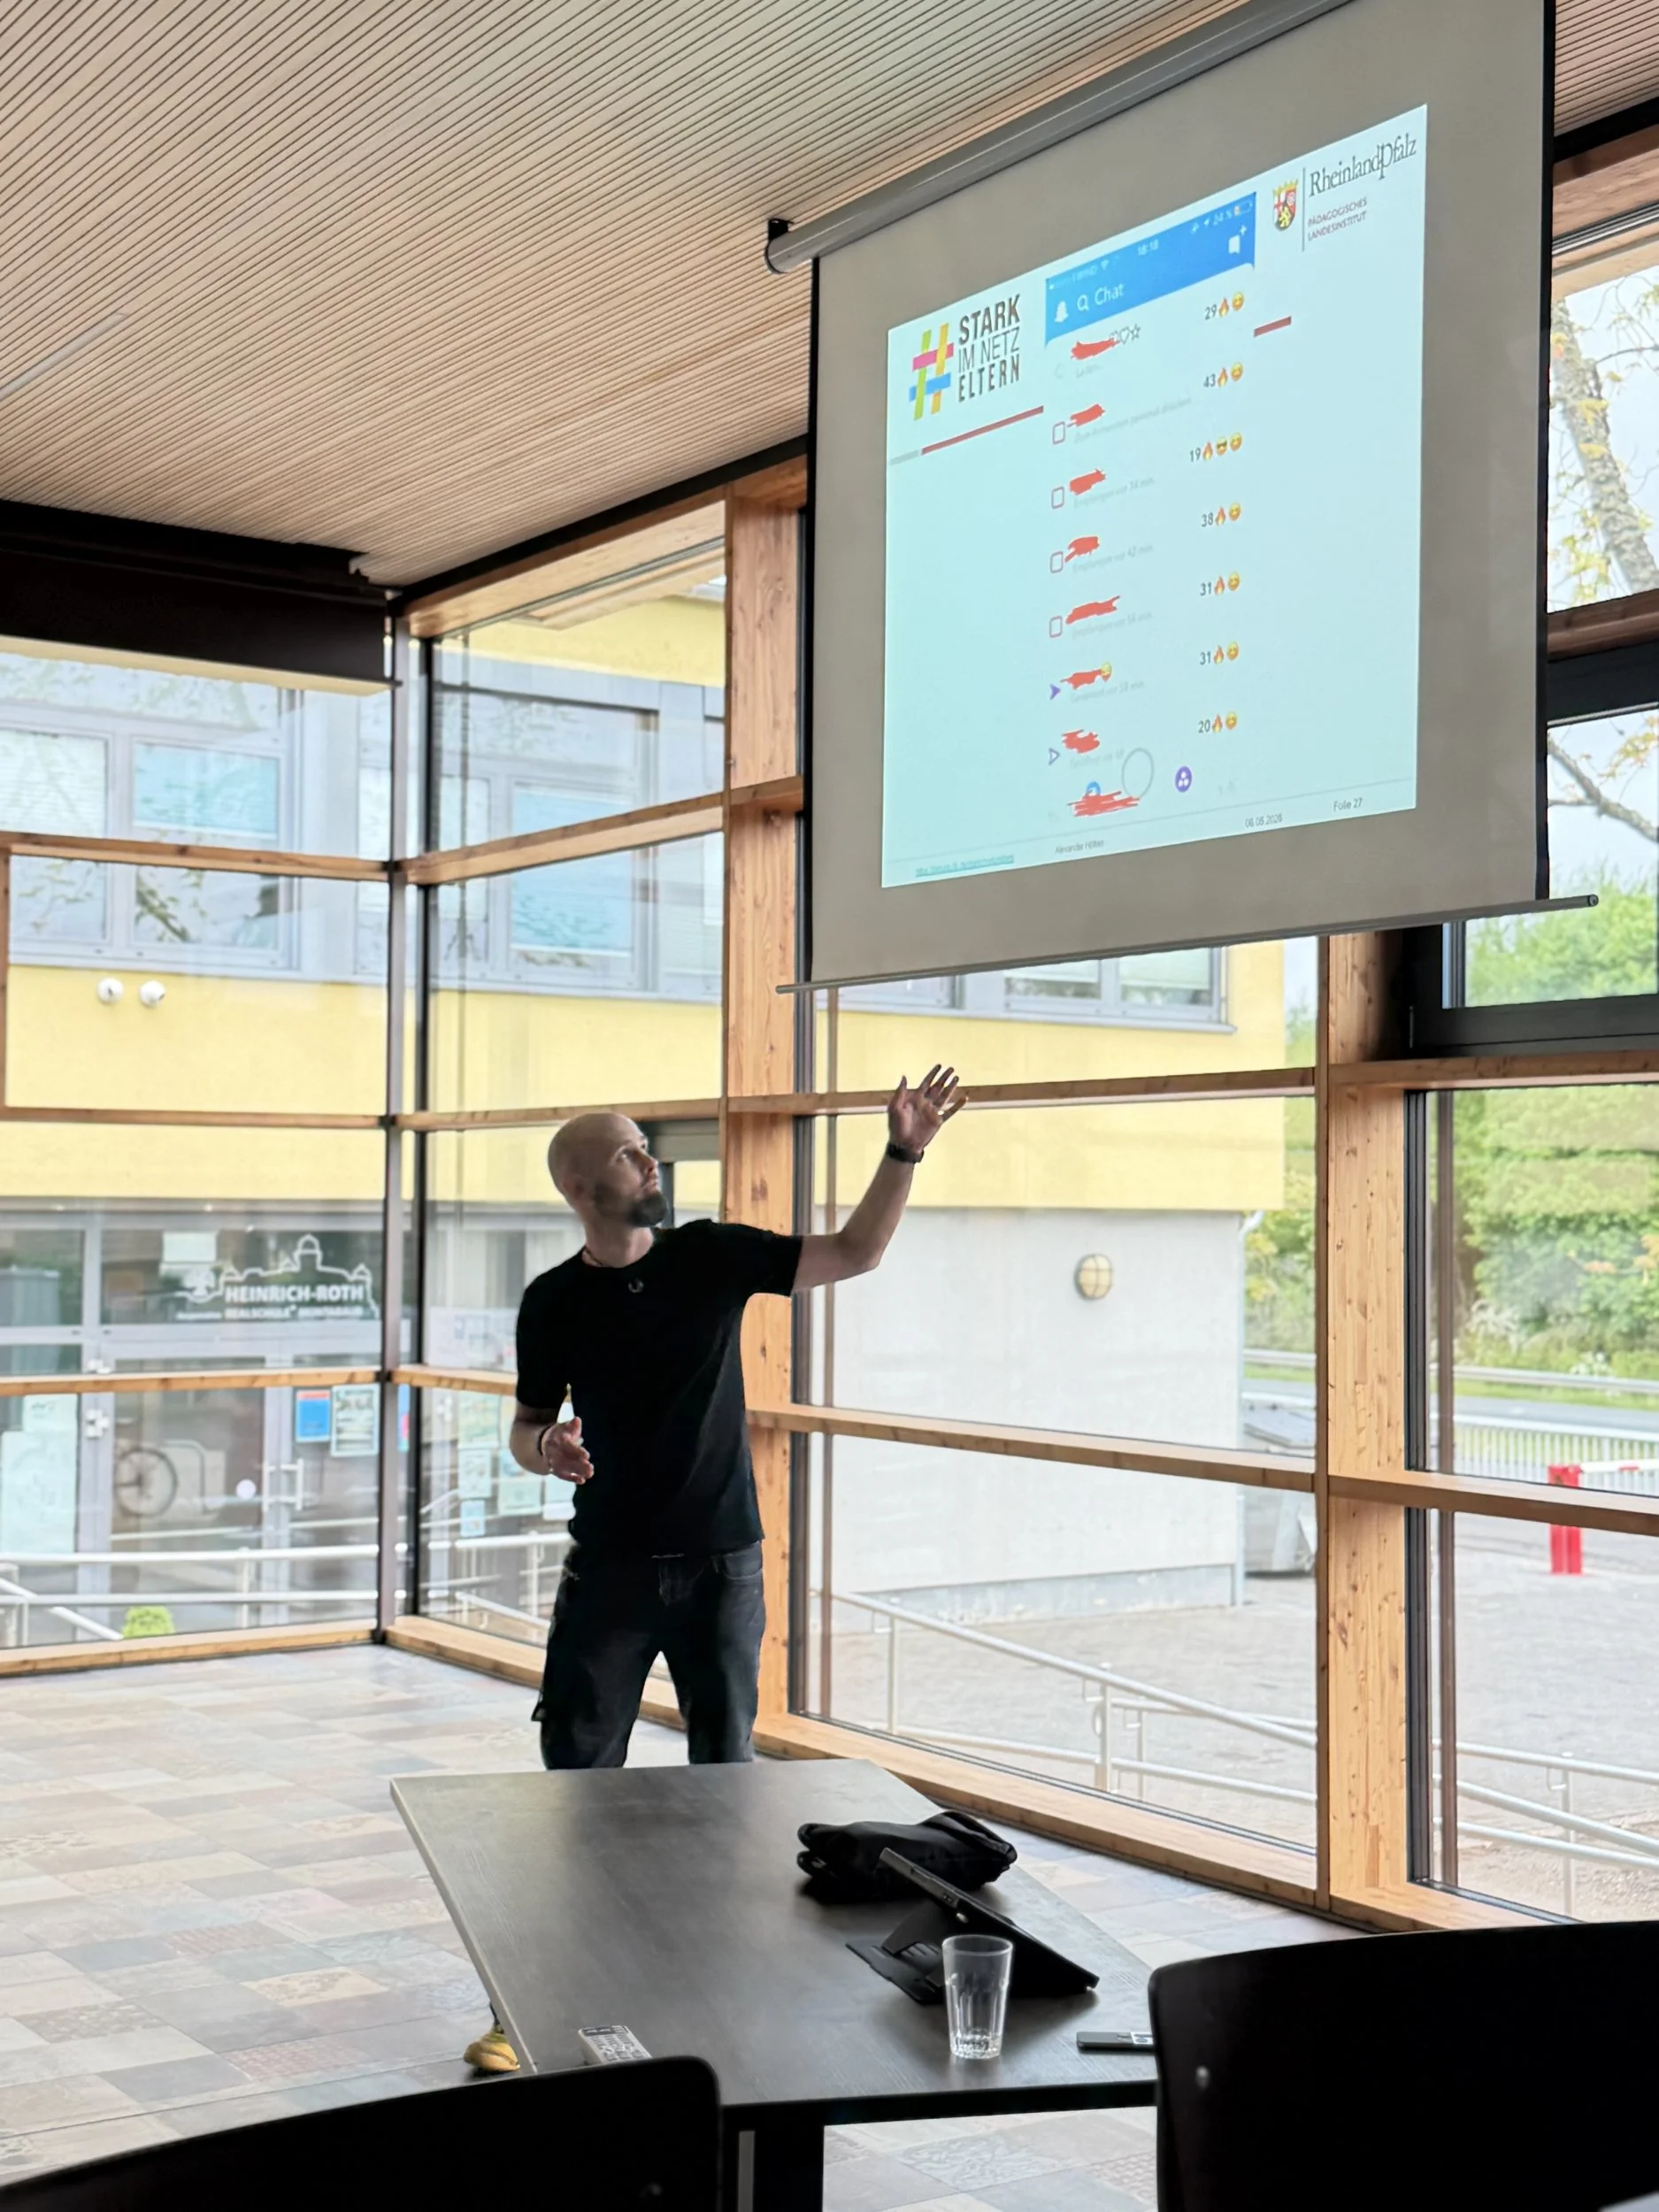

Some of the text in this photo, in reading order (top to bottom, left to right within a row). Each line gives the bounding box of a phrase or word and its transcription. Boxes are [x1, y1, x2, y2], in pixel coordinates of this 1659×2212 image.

[1308, 211, 1367, 242] LANDESINSTITUT
[1094, 282, 1125, 305] Chat
[959, 294, 1020, 345] STARK
[1205, 303, 1217, 320] 29
[958, 326, 1020, 373] IM NETZ
[958, 354, 1020, 403] ELTERN
[1203, 373, 1216, 388] 43
[1190, 447, 1201, 462] 19
[1202, 511, 1214, 527] 38
[1200, 582, 1211, 596] 31
[1200, 652, 1211, 665] 31
[1198, 719, 1211, 733] 20
[1333, 797, 1363, 811] Folie 27
[225, 1284, 365, 1303] HEINRICH-ROTH
